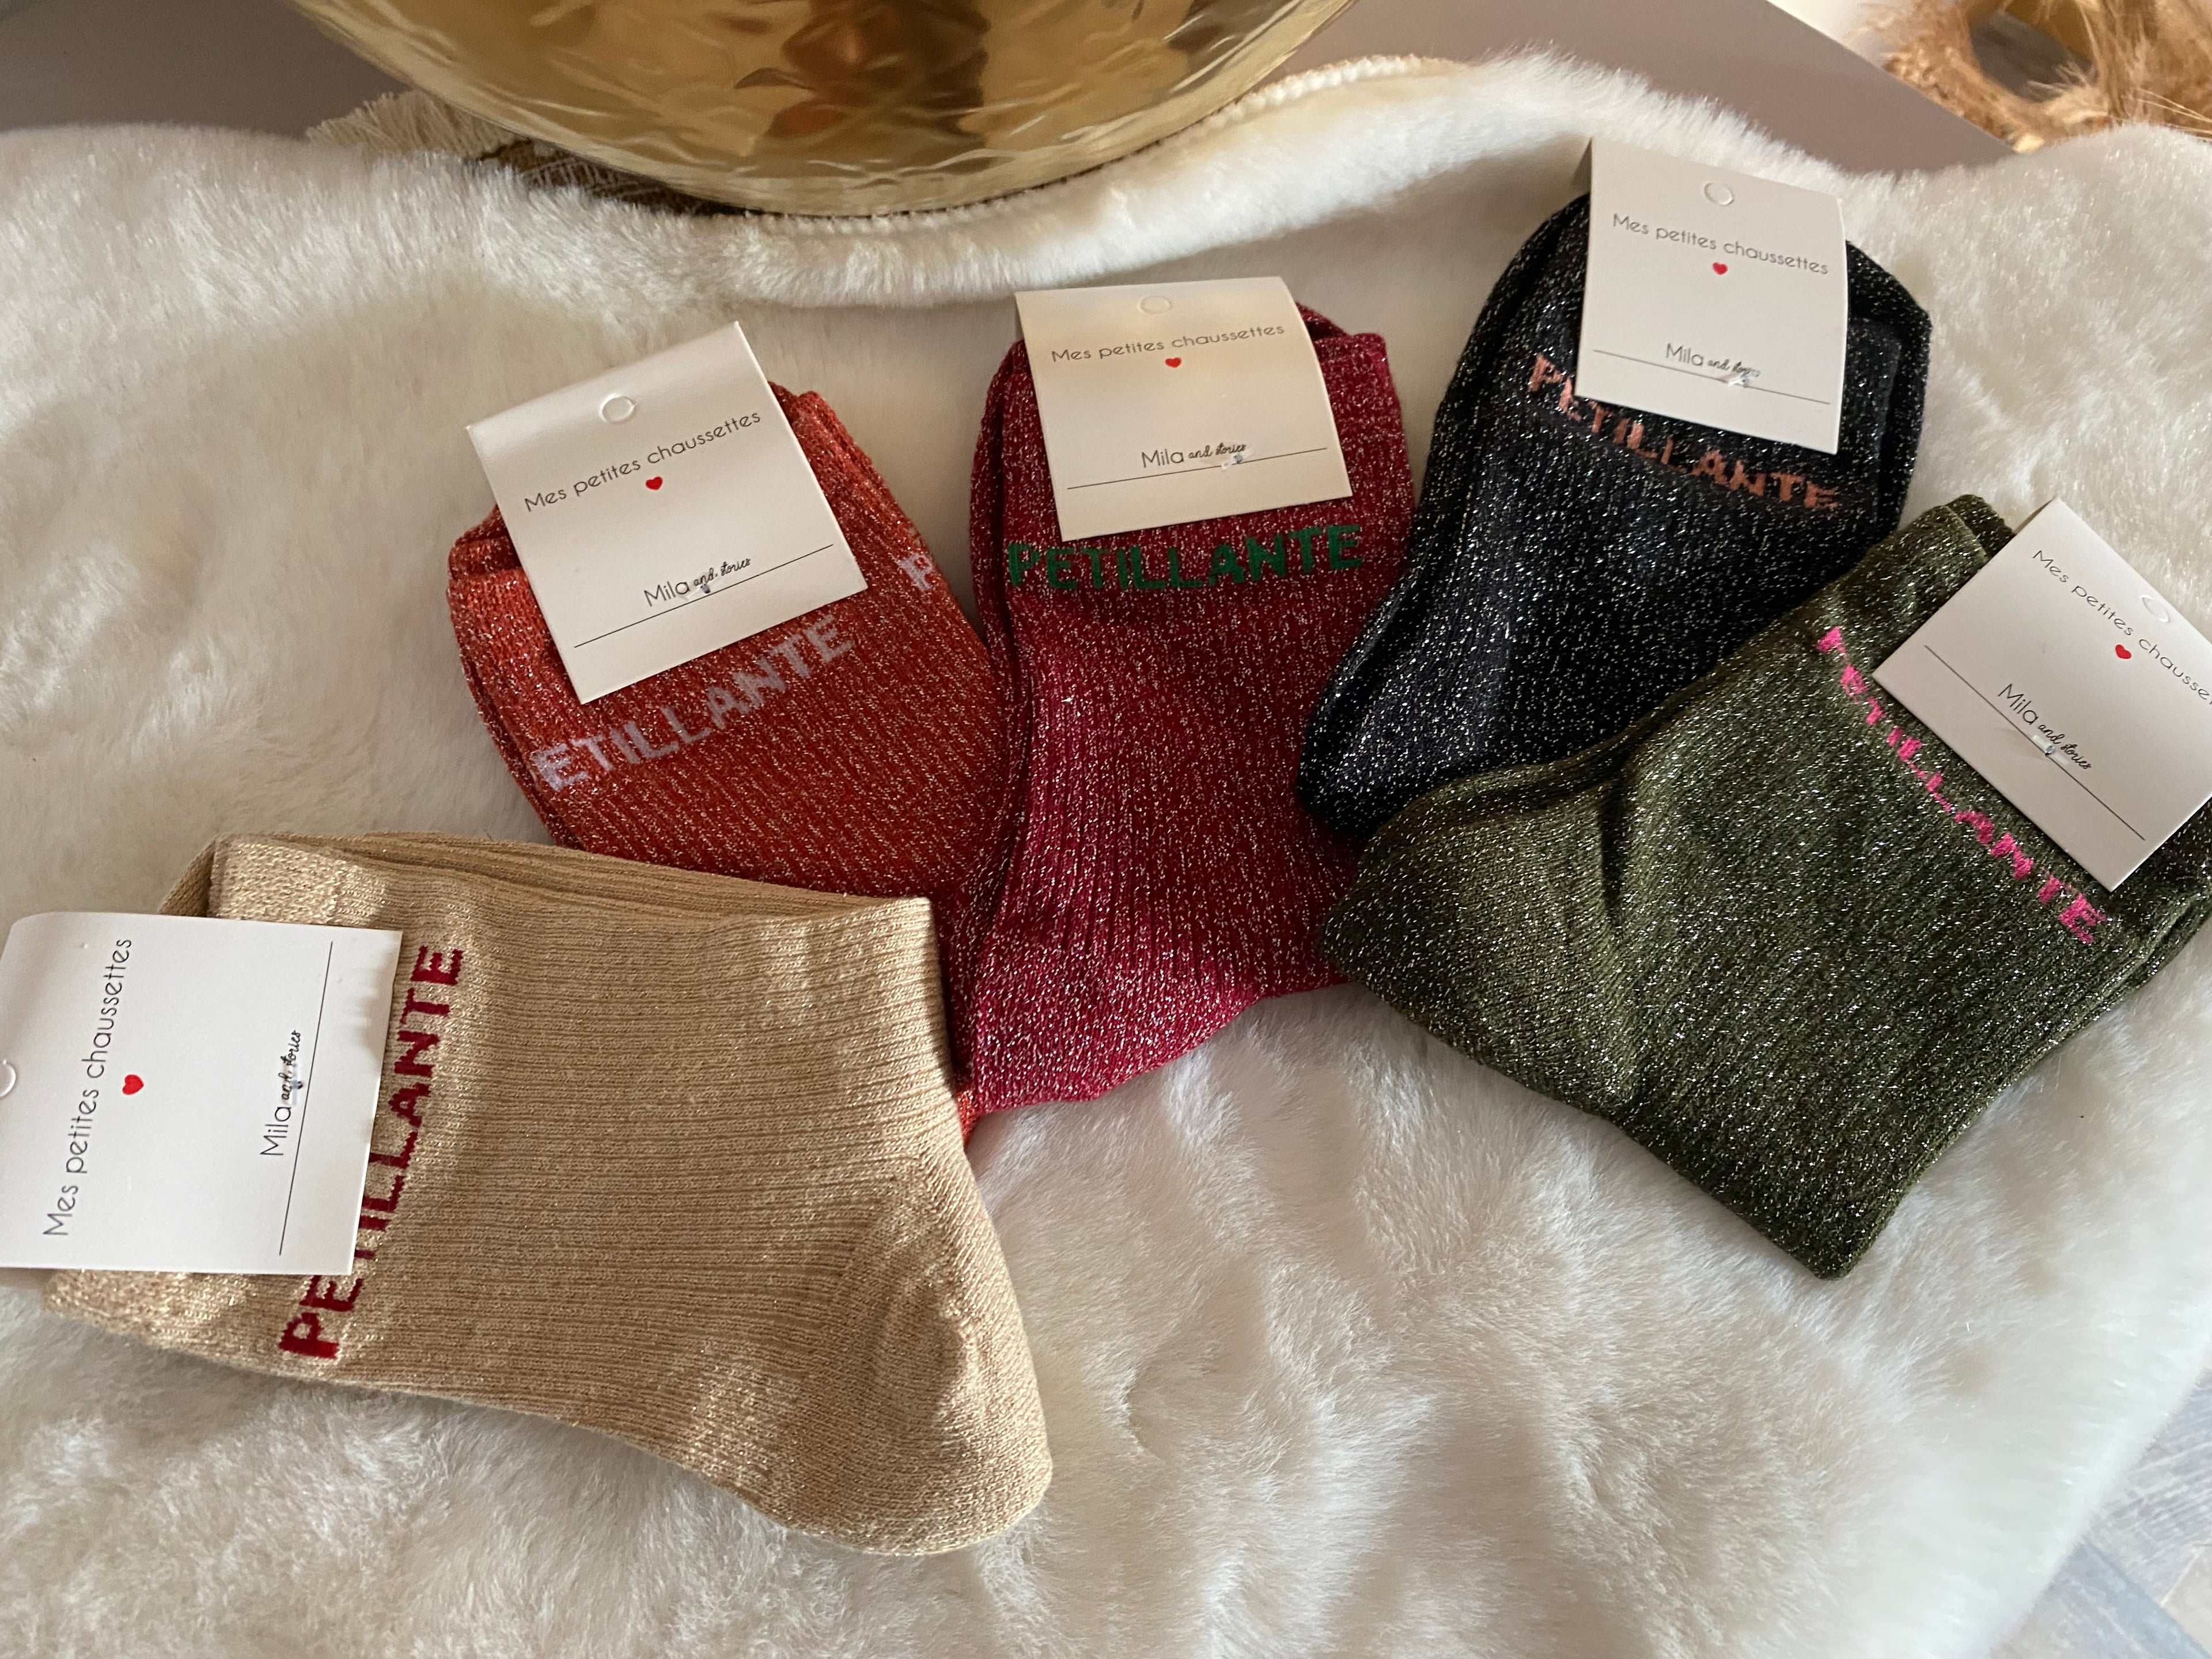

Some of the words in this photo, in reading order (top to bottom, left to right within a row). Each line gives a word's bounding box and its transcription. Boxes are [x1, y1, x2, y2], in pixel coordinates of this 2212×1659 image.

[1612, 213, 1649, 235] Mes
[1656, 224, 1717, 251] petites
[1724, 240, 1829, 275] chaussettes
[1051, 349, 1092, 363] Mes
[1099, 340, 1165, 359] petites
[1172, 324, 1285, 349] chaussettes
[1666, 343, 1704, 366] Mila
[1707, 359, 1730, 371] and
[524, 487, 567, 512] Mes
[574, 457, 641, 497] petites
[646, 411, 762, 465] chaussettes
[1142, 448, 1184, 468] Mila
[1188, 445, 1212, 459] and
[644, 581, 690, 607] Mila
[721, 558, 751, 576] stories
[1007, 524, 1363, 590] PETILLANTE
[2032, 550, 2069, 584] Mes
[2071, 584, 2134, 637] petites
[2139, 639, 2212, 706] chausse
[1998, 683, 2039, 725] Mila
[2038, 724, 2065, 744] and
[2061, 744, 2092, 770] stories
[81, 938, 132, 1079] chaussettes
[65, 1088, 100, 1175] petites
[260, 1106, 291, 1156] Mila
[43, 1184, 79, 1236] Mes
